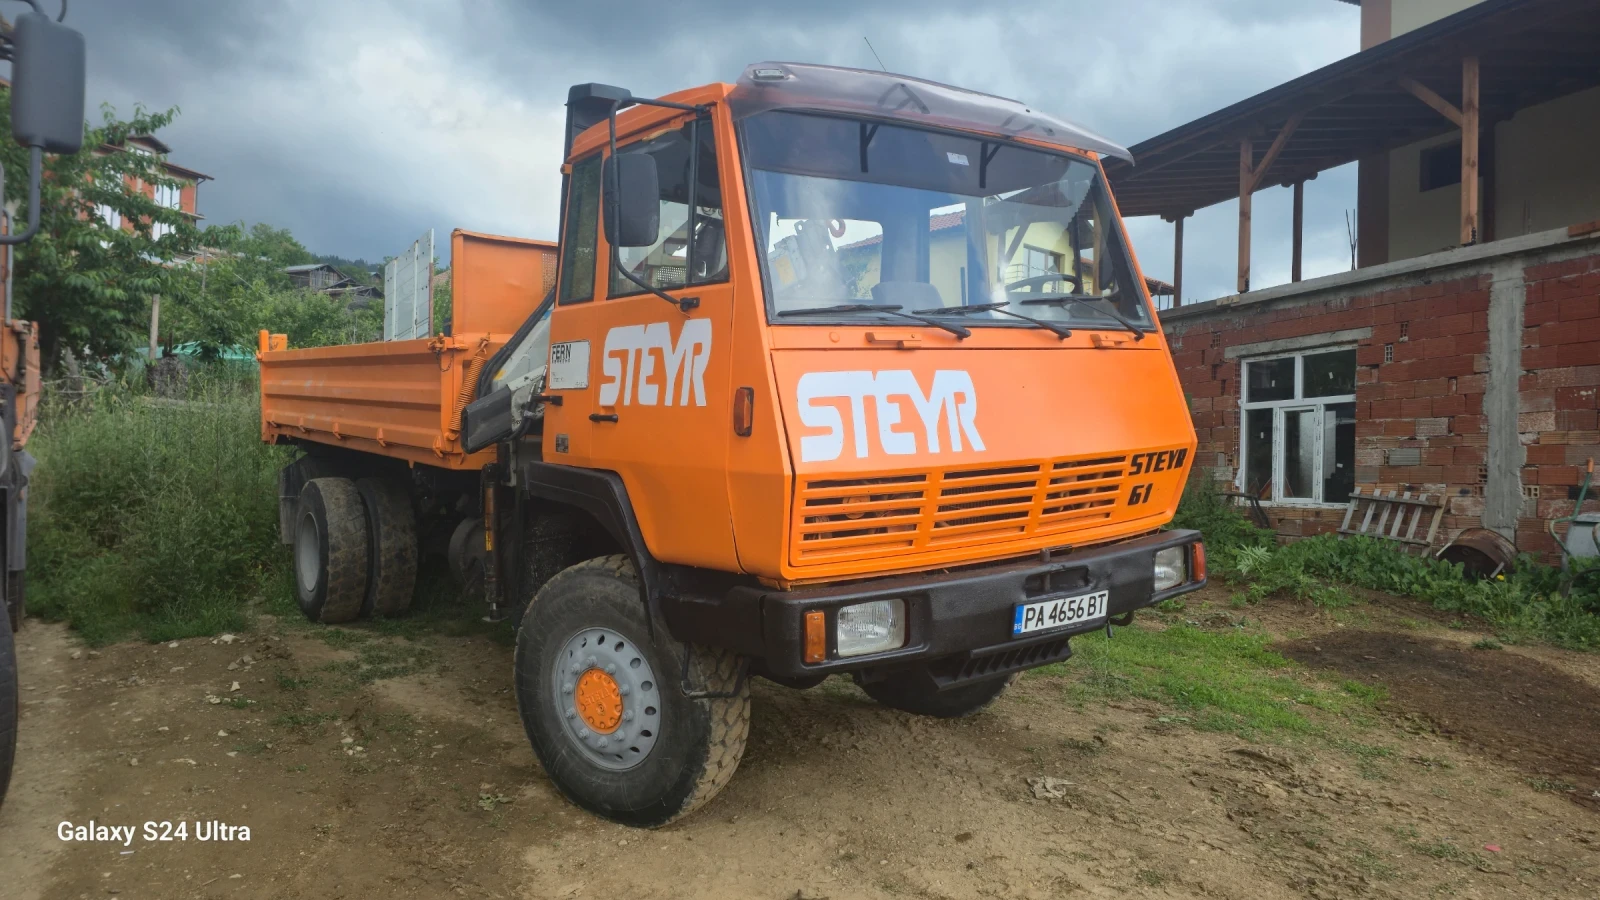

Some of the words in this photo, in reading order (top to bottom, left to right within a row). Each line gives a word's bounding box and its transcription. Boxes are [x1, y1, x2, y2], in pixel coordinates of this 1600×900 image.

[599, 318, 712, 406] STEYR
[797, 369, 987, 462] STEYR
[1128, 448, 1188, 476] STEYR
[1127, 483, 1154, 506] 61
[1024, 605, 1044, 629] PA
[1048, 598, 1084, 624] 4656
[1087, 592, 1107, 617] BT
